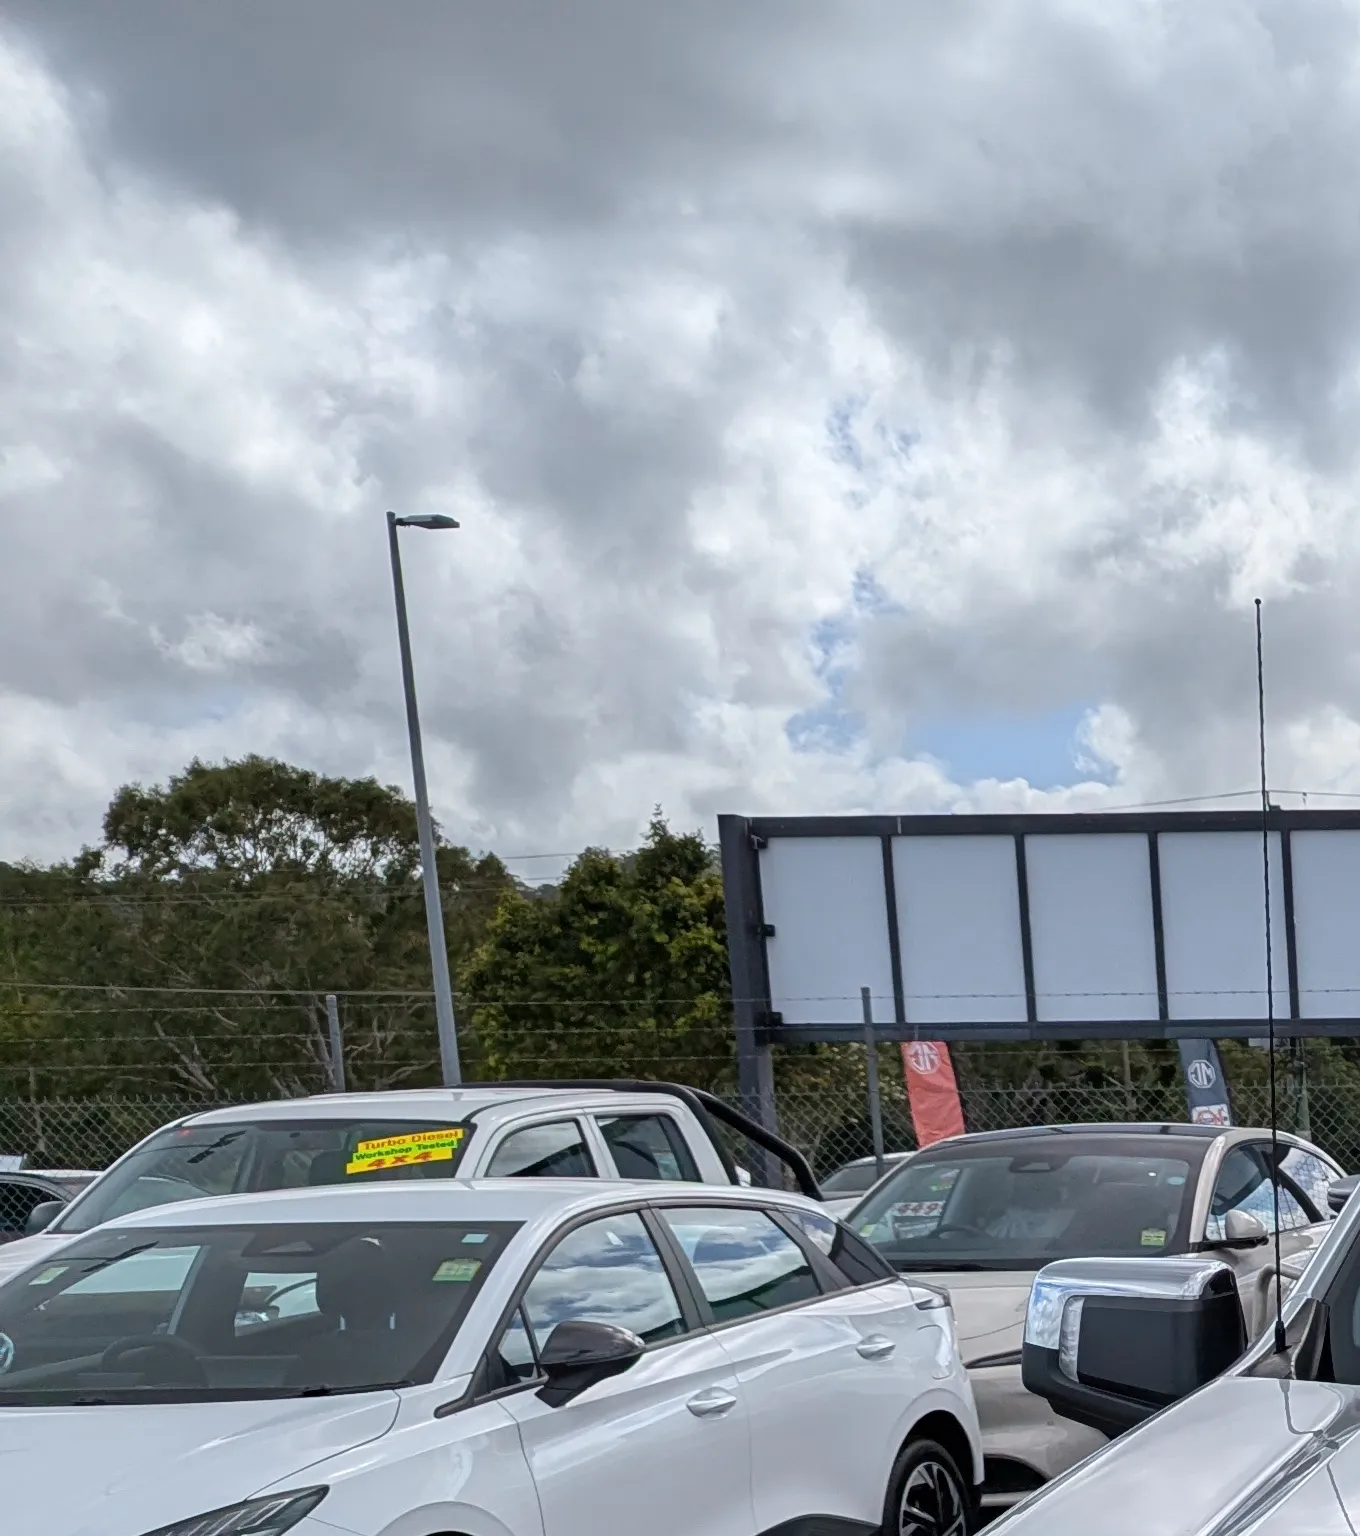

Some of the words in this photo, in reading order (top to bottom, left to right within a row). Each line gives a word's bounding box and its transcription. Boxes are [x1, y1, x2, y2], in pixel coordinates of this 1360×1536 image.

[355, 1147, 413, 1160] Workshop
[415, 1140, 456, 1150] Tested
[364, 1140, 408, 1150] Turbo
[411, 1131, 459, 1141] Diesel
